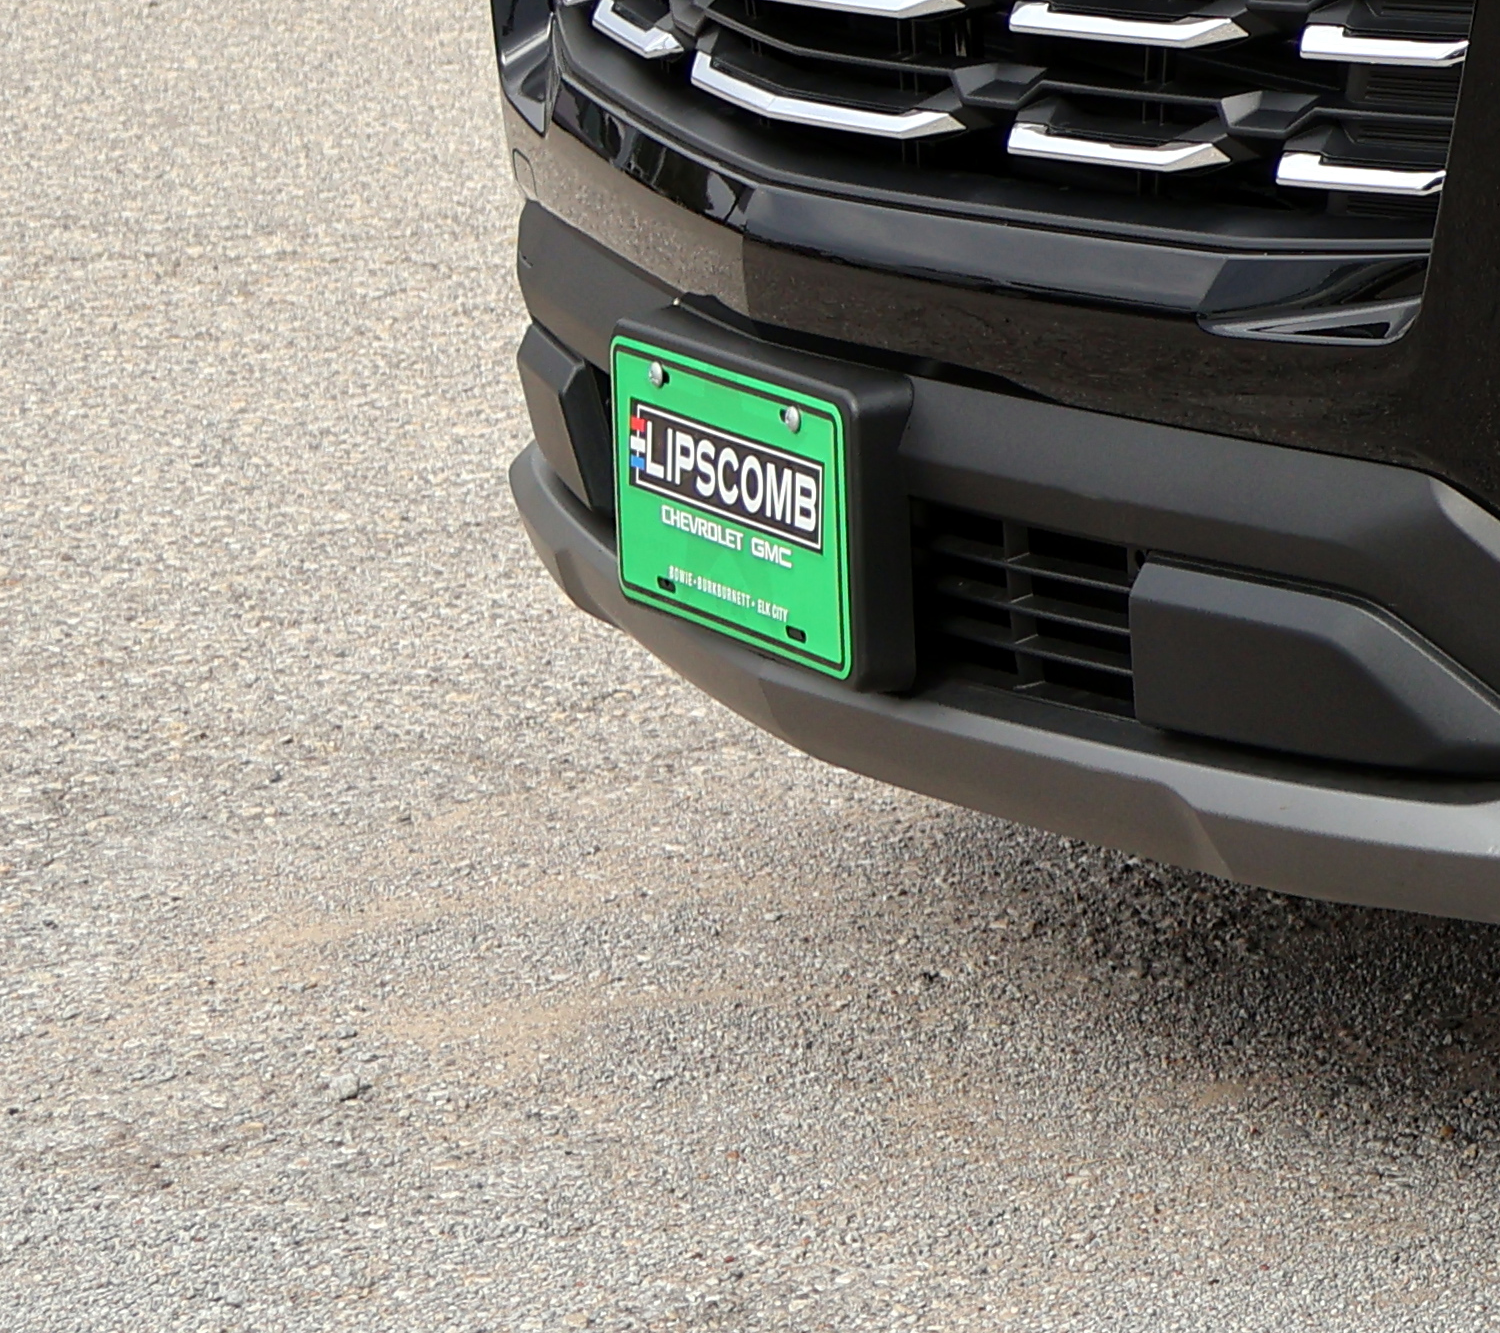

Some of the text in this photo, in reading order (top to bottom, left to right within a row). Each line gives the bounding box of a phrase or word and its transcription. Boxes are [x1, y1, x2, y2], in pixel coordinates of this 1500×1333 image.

[645, 420, 817, 532] LIPSCOMB
[661, 504, 793, 569] CHEVROLET GMC
[668, 565, 693, 586] BOWIE
[757, 599, 771, 617] ELK
